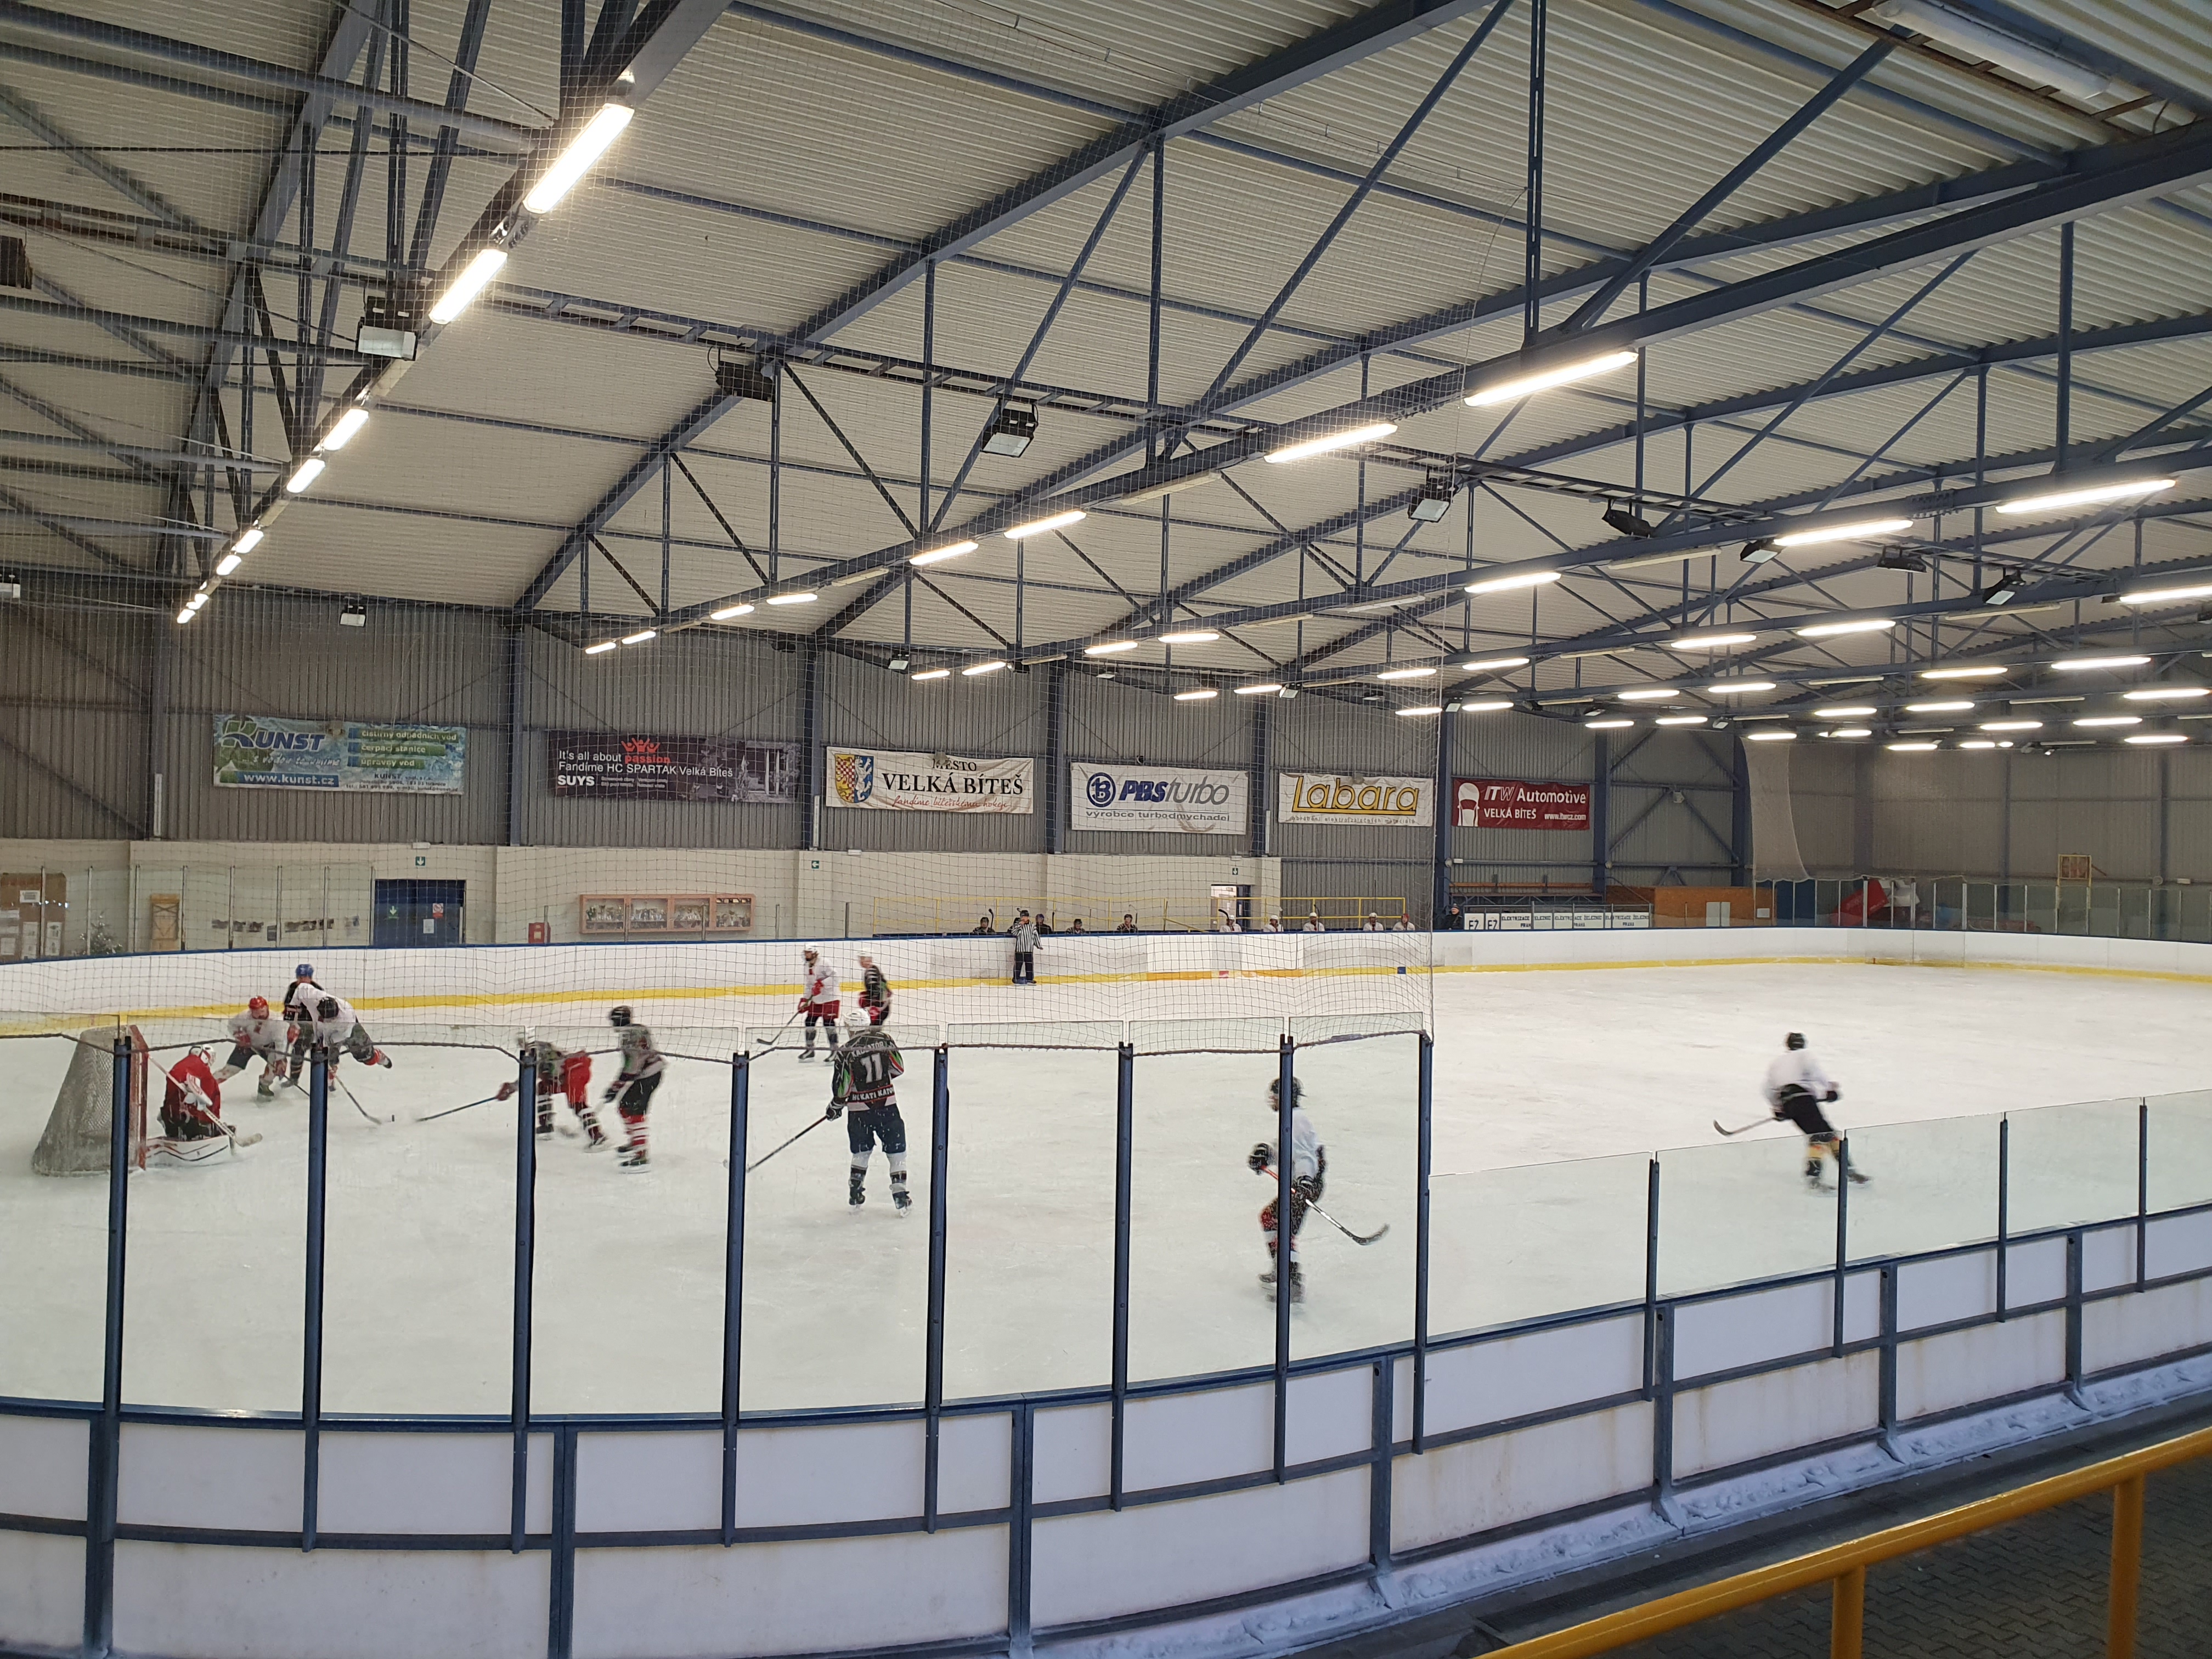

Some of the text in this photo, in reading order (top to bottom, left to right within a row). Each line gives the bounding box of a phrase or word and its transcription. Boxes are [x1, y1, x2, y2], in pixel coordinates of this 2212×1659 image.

[222, 720, 326, 752] KUNST
[559, 751, 670, 764] It's all about passion
[559, 761, 733, 777] Fandíme HC SPARTAK Velká Bíteš
[244, 774, 334, 785] www.kunst.cz
[557, 775, 595, 786] SUYS
[882, 772, 1023, 795] VELKÁ BÍTEŠ
[891, 794, 929, 806] fandíme
[1291, 775, 1419, 816] Labara
[1484, 786, 1586, 804] ITW Automotive
[1086, 810, 1230, 821] výrobce turbodmychadel
[1484, 807, 1536, 819] VELKÁ BÍTEŠ
[861, 1053, 883, 1084] 11
